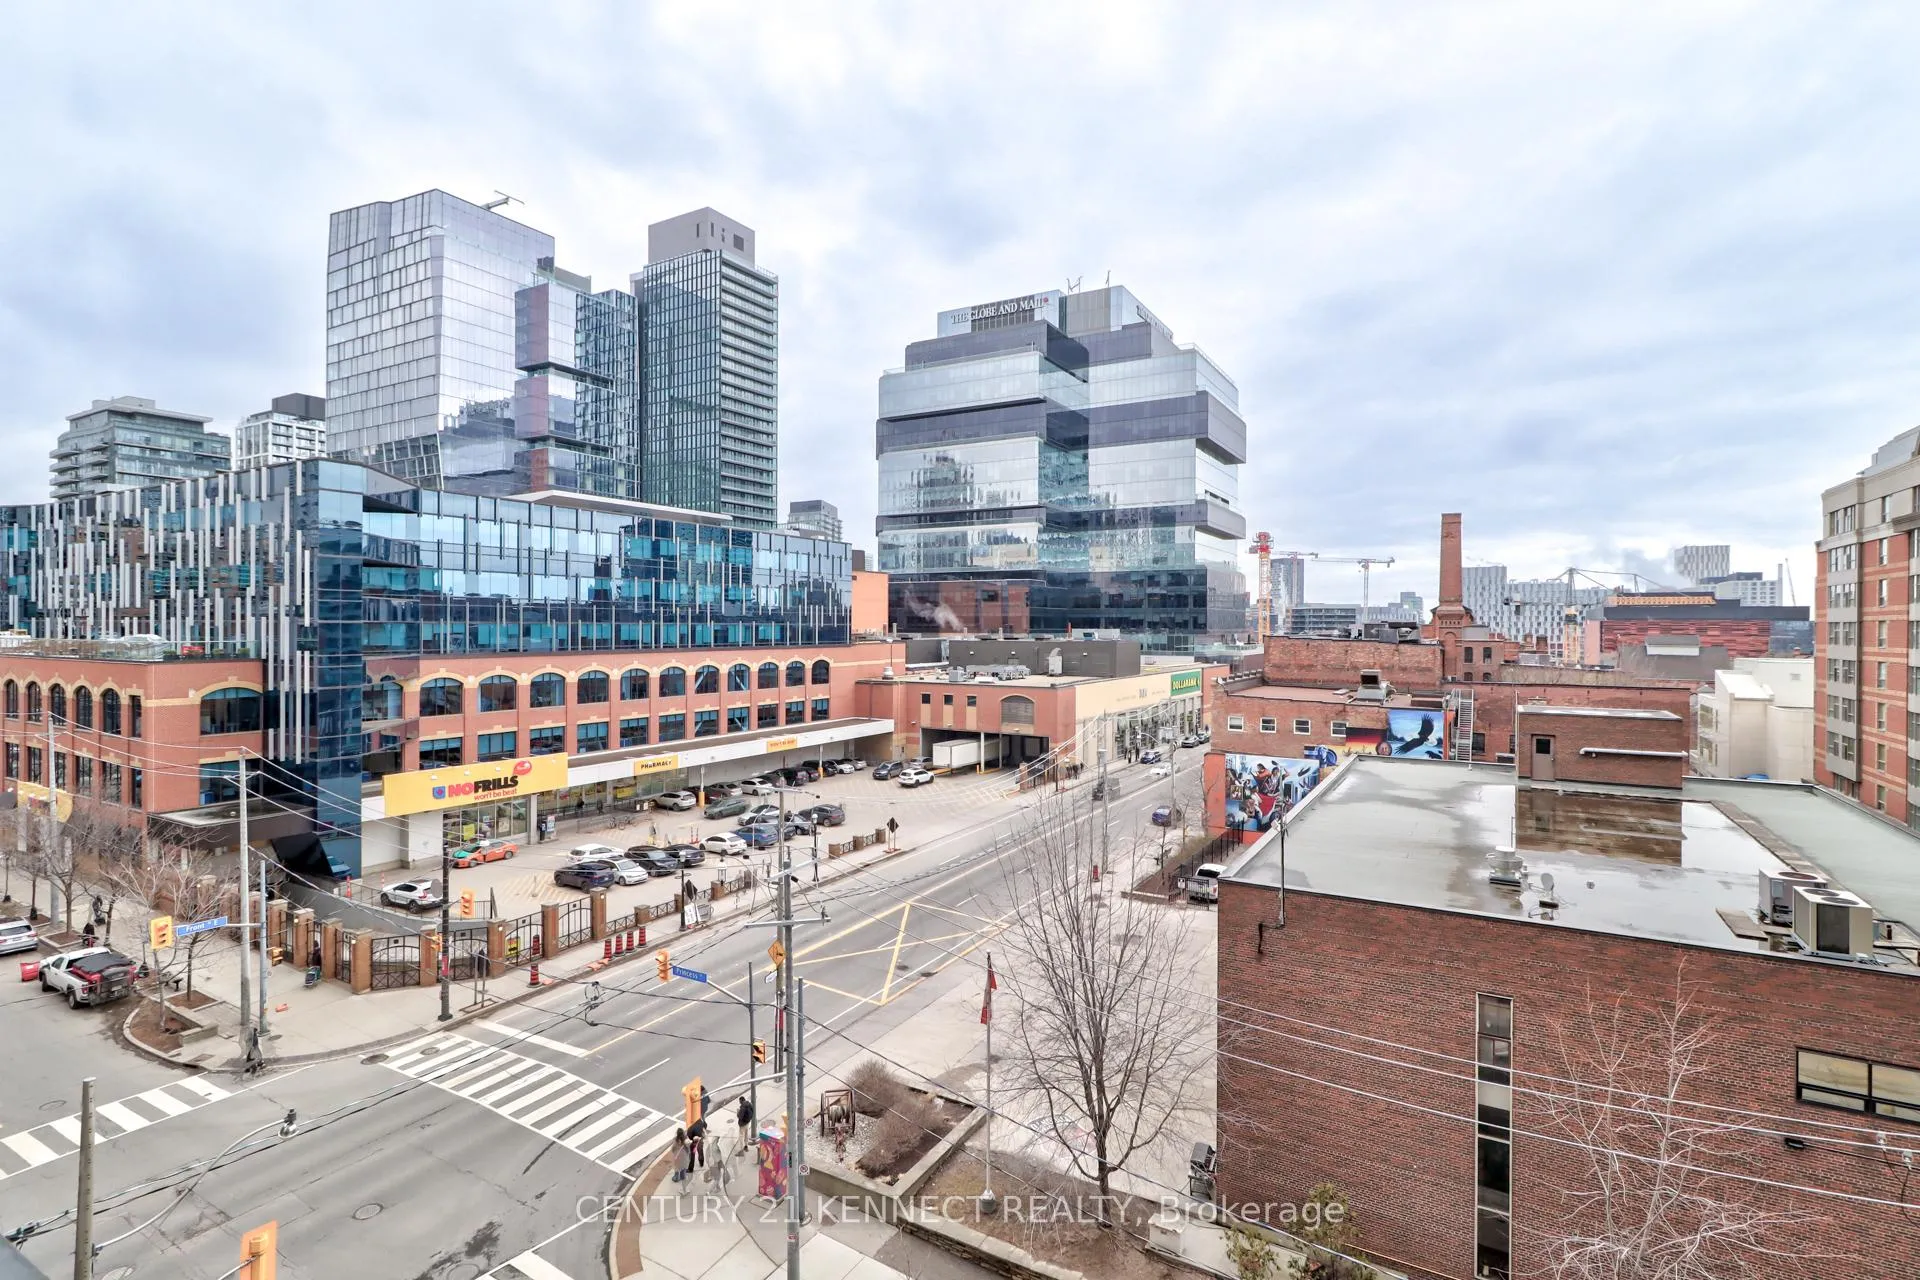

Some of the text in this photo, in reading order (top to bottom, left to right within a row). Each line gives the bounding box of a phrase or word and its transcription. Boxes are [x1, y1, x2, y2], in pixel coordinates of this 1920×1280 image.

[951, 313, 969, 324] THE
[970, 307, 996, 320] GLOBE
[998, 302, 1018, 316] AND
[186, 923, 205, 933] Front
[676, 968, 698, 980] Princess
